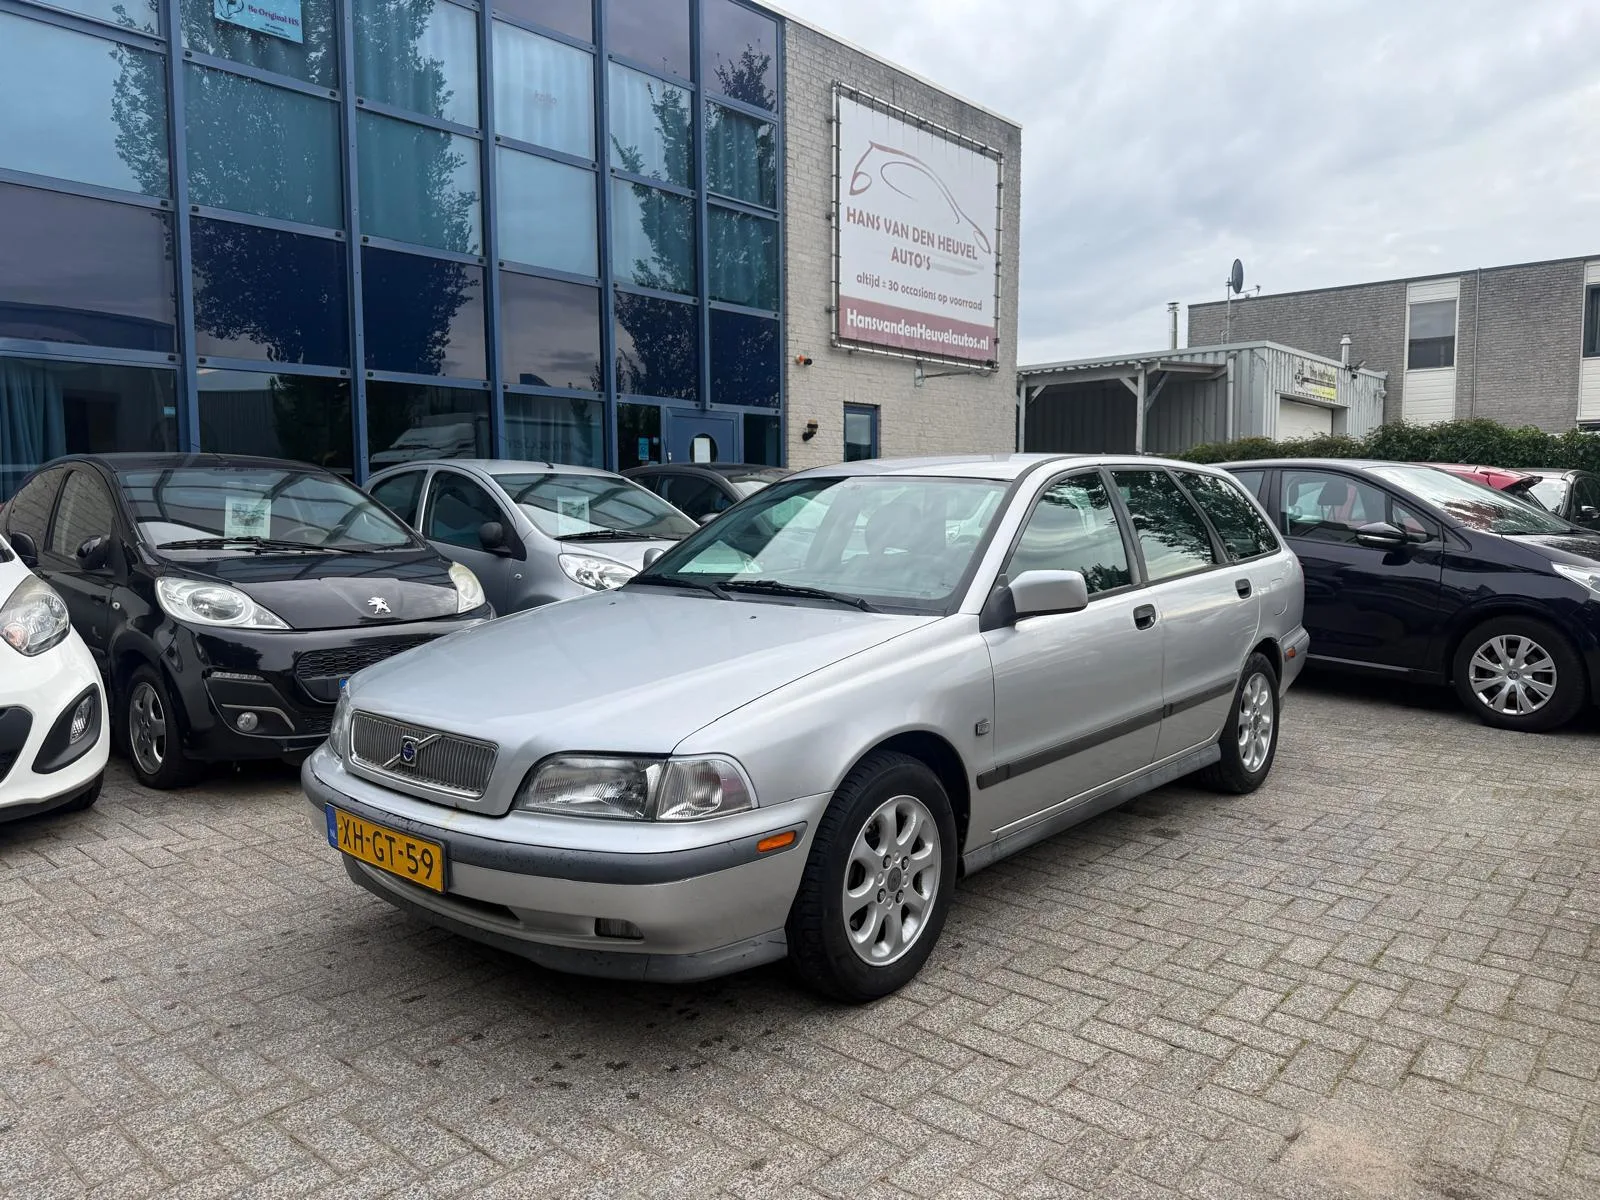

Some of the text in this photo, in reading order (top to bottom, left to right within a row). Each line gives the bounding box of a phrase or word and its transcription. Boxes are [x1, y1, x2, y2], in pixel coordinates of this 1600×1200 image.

[846, 206, 978, 260] HANS VAN DEN HEUVEL
[891, 246, 931, 270] AUTO'S
[856, 271, 880, 288] altijd
[888, 280, 899, 292] 30
[900, 285, 936, 300] occasions
[937, 293, 948, 304] op
[949, 296, 982, 311] voorraad
[846, 308, 989, 350] HansvandenHeuvelautos.nl
[342, 815, 434, 880] XH-GT-59
